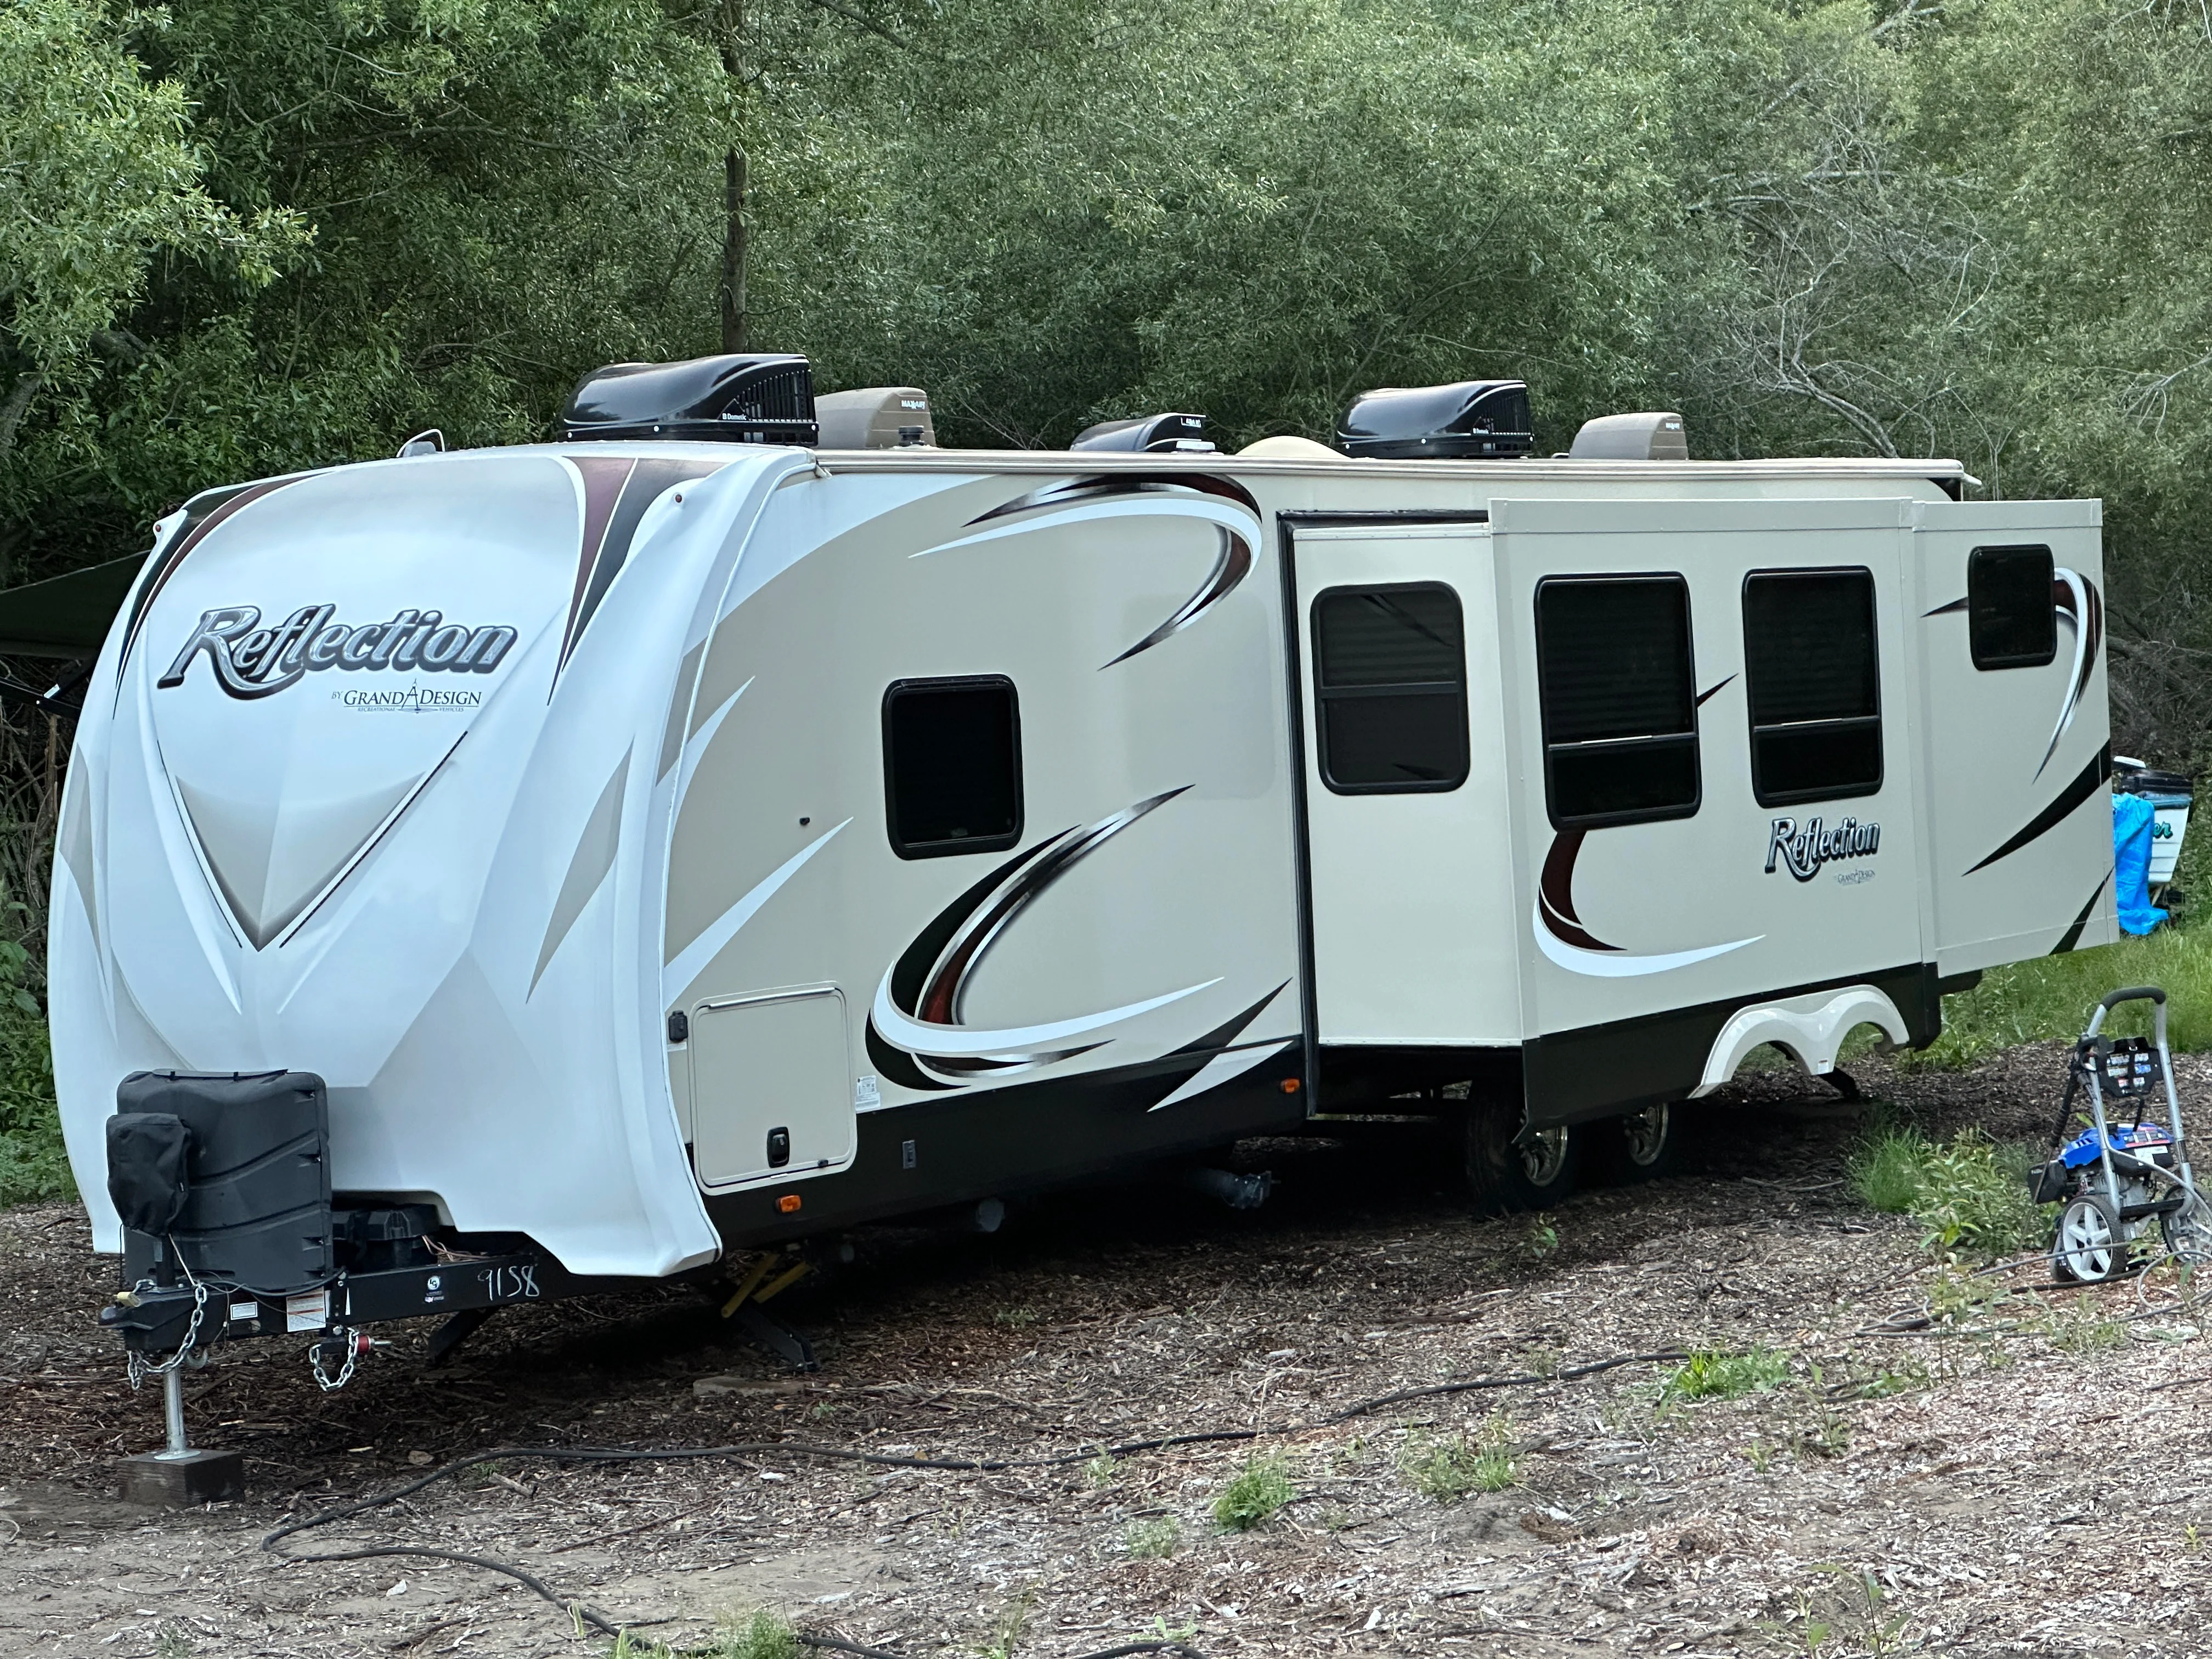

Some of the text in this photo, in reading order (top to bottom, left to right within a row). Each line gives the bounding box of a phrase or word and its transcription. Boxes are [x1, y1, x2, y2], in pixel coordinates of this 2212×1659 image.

[157, 603, 518, 701] Reflection
[331, 690, 482, 705] BY GRAND DESIGN
[2153, 821, 2174, 839] er
[1764, 816, 1881, 883] Reflection
[477, 1265, 540, 1301] 9158
